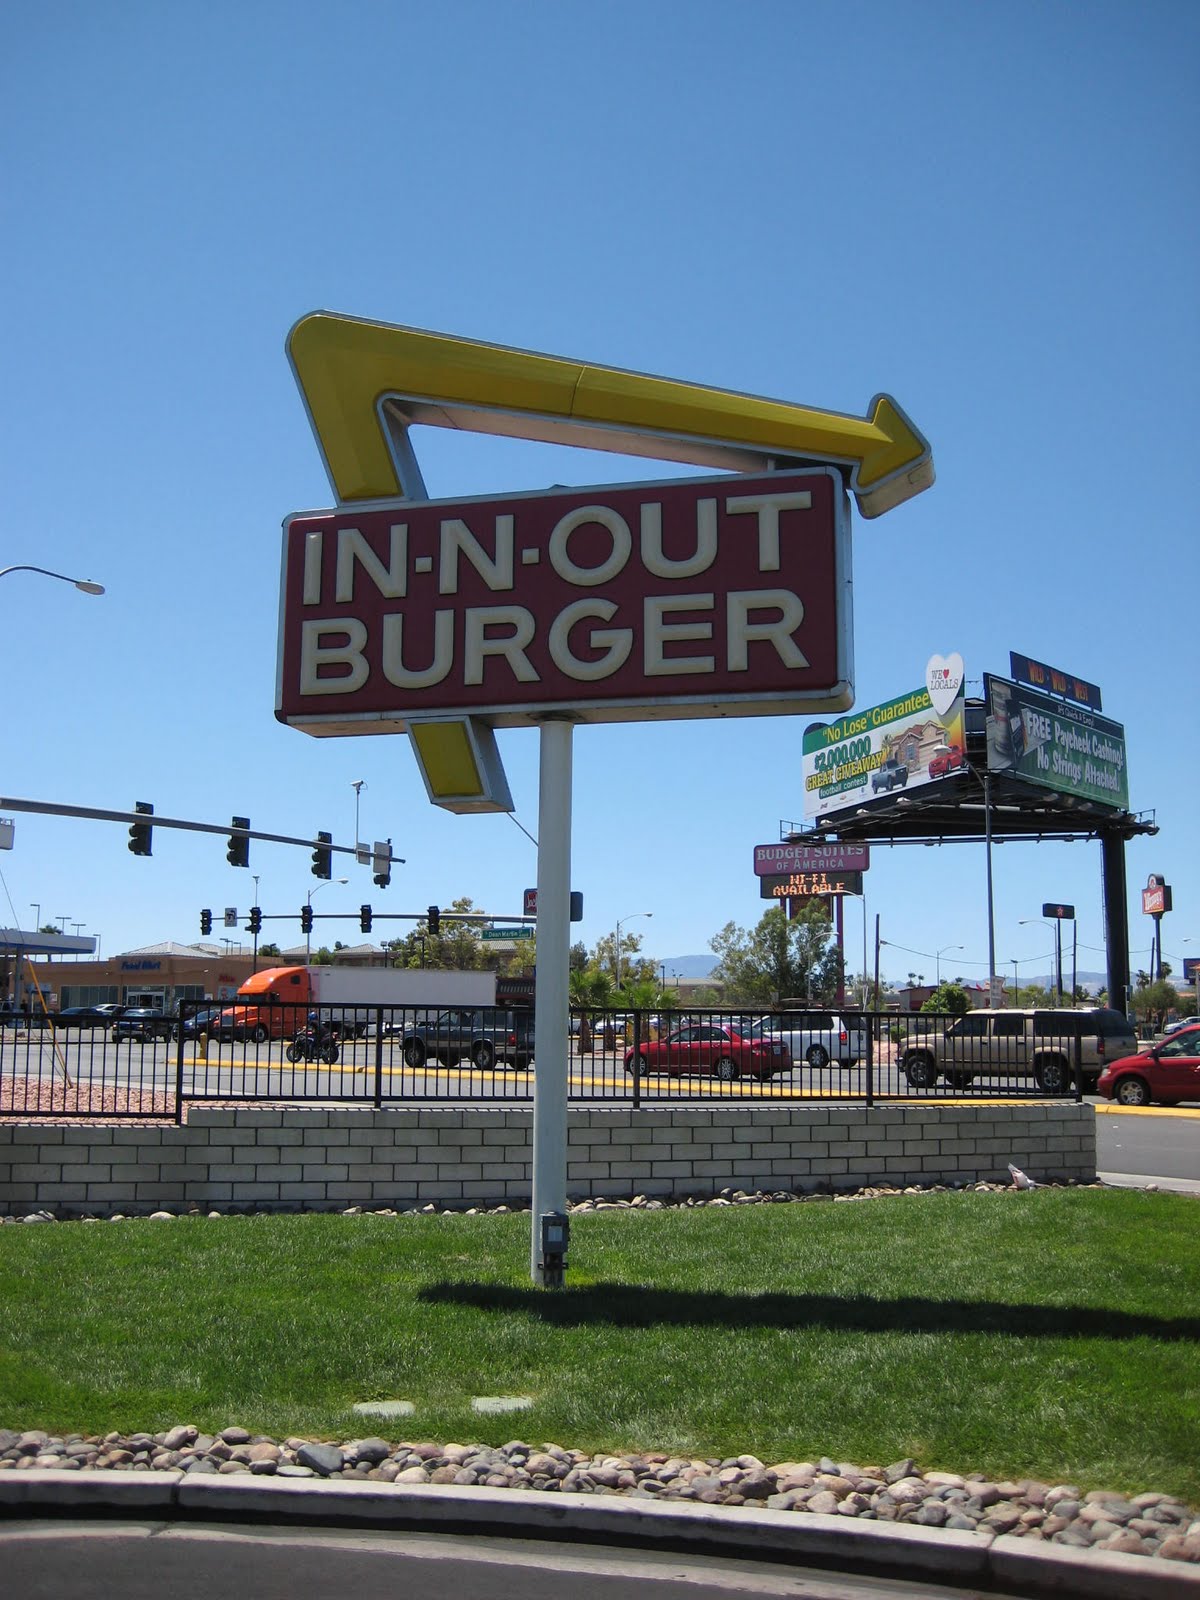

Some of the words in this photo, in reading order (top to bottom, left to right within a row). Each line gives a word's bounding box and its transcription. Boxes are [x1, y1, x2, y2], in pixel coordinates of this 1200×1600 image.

[303, 491, 812, 606] IN-N-OUT
[300, 589, 811, 696] BURGER
[930, 679, 959, 690] LOCALS
[931, 669, 943, 680] WE
[872, 692, 932, 725] Guarantee
[1026, 711, 1052, 741] FREE
[1054, 721, 1092, 758] Paycheck
[1093, 735, 1123, 770] Cashing!
[806, 769, 834, 792] GREAT
[835, 752, 884, 781] GIVEAWAY
[1037, 745, 1050, 770] No
[1053, 749, 1082, 785] Strings
[1085, 761, 1121, 792] Attached.
[820, 783, 843, 798] football
[843, 775, 868, 790] contest
[757, 847, 811, 861] BUDGET
[814, 846, 865, 857] SUITES
[776, 861, 789, 871] OF
[793, 859, 845, 870] AMERICA
[773, 882, 845, 896] AVAILABLE
